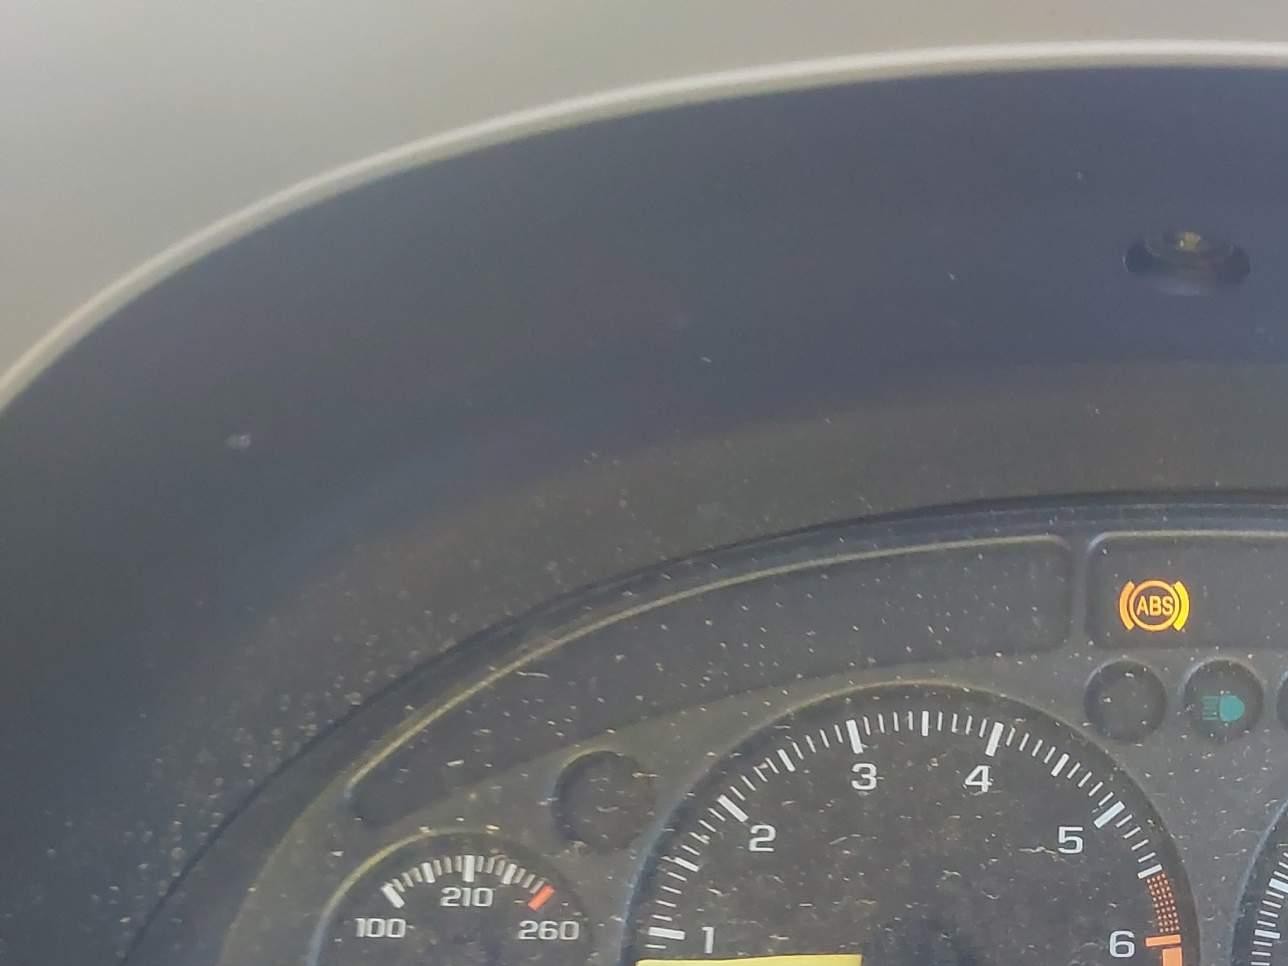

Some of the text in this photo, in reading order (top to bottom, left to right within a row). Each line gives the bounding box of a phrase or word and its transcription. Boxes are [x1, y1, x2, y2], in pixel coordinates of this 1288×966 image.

[1136, 595, 1174, 616] ABS
[851, 763, 878, 790] 3
[964, 765, 992, 793] 4
[748, 824, 776, 852] 2
[1057, 826, 1084, 854] 5
[440, 887, 494, 907] 210
[355, 918, 407, 938] 100
[518, 920, 580, 940] 260
[702, 926, 716, 953] 1
[1109, 929, 1136, 958] 6
